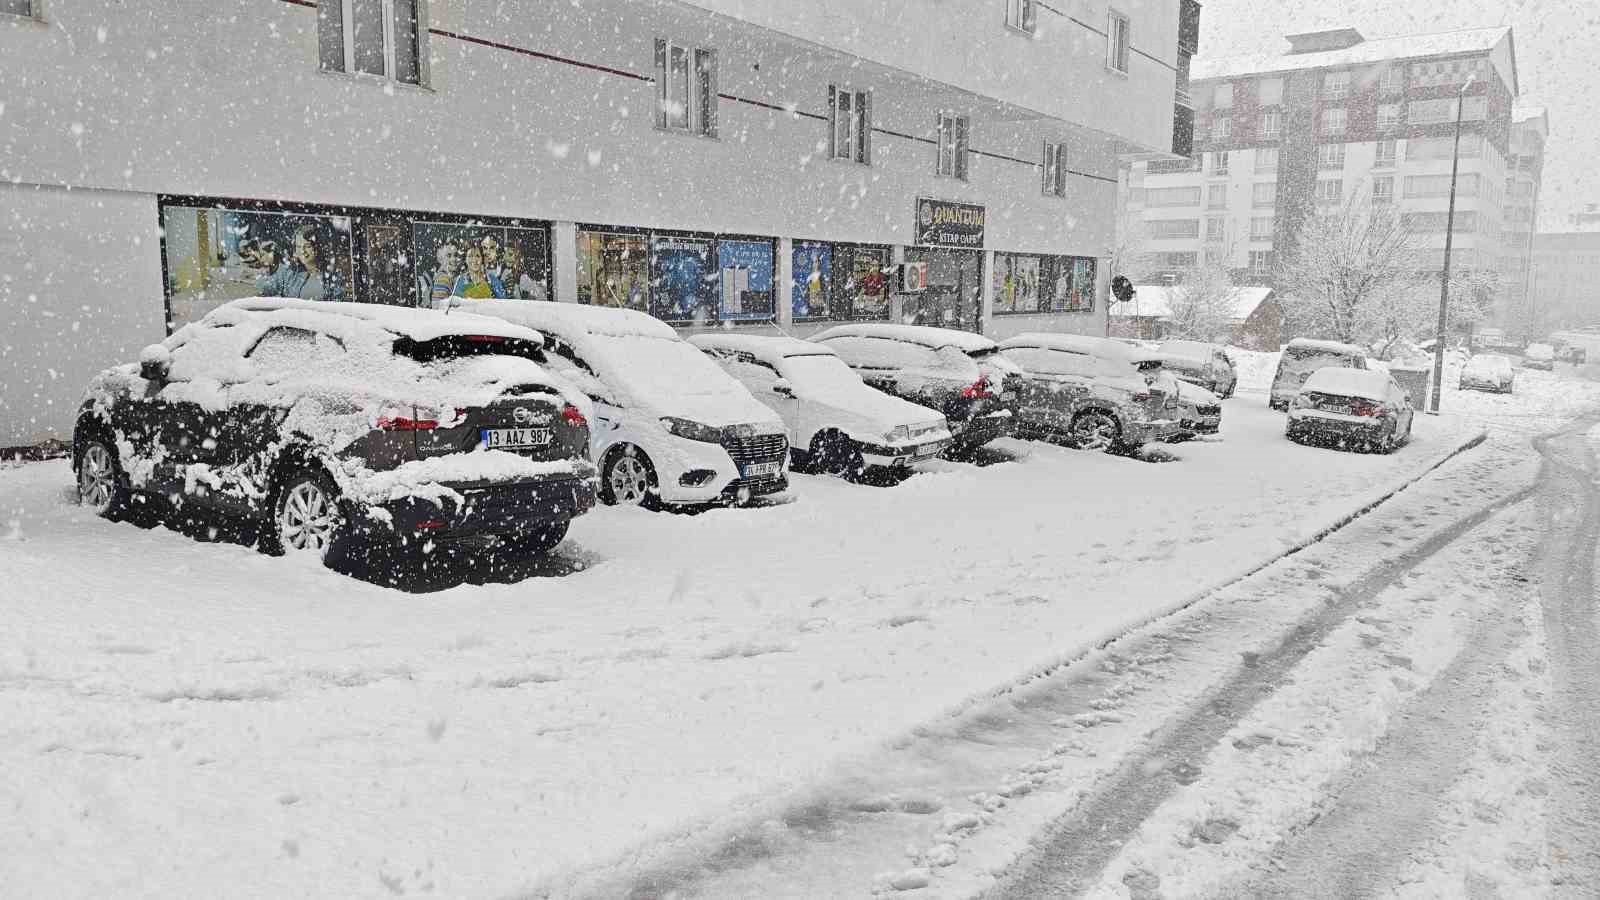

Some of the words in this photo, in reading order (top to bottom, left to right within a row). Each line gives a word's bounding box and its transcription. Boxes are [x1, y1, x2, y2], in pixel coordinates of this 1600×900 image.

[933, 206, 984, 225] QUANTUM
[488, 431, 499, 446] 13
[506, 430, 525, 445] AAZ
[530, 429, 548, 443] 987
